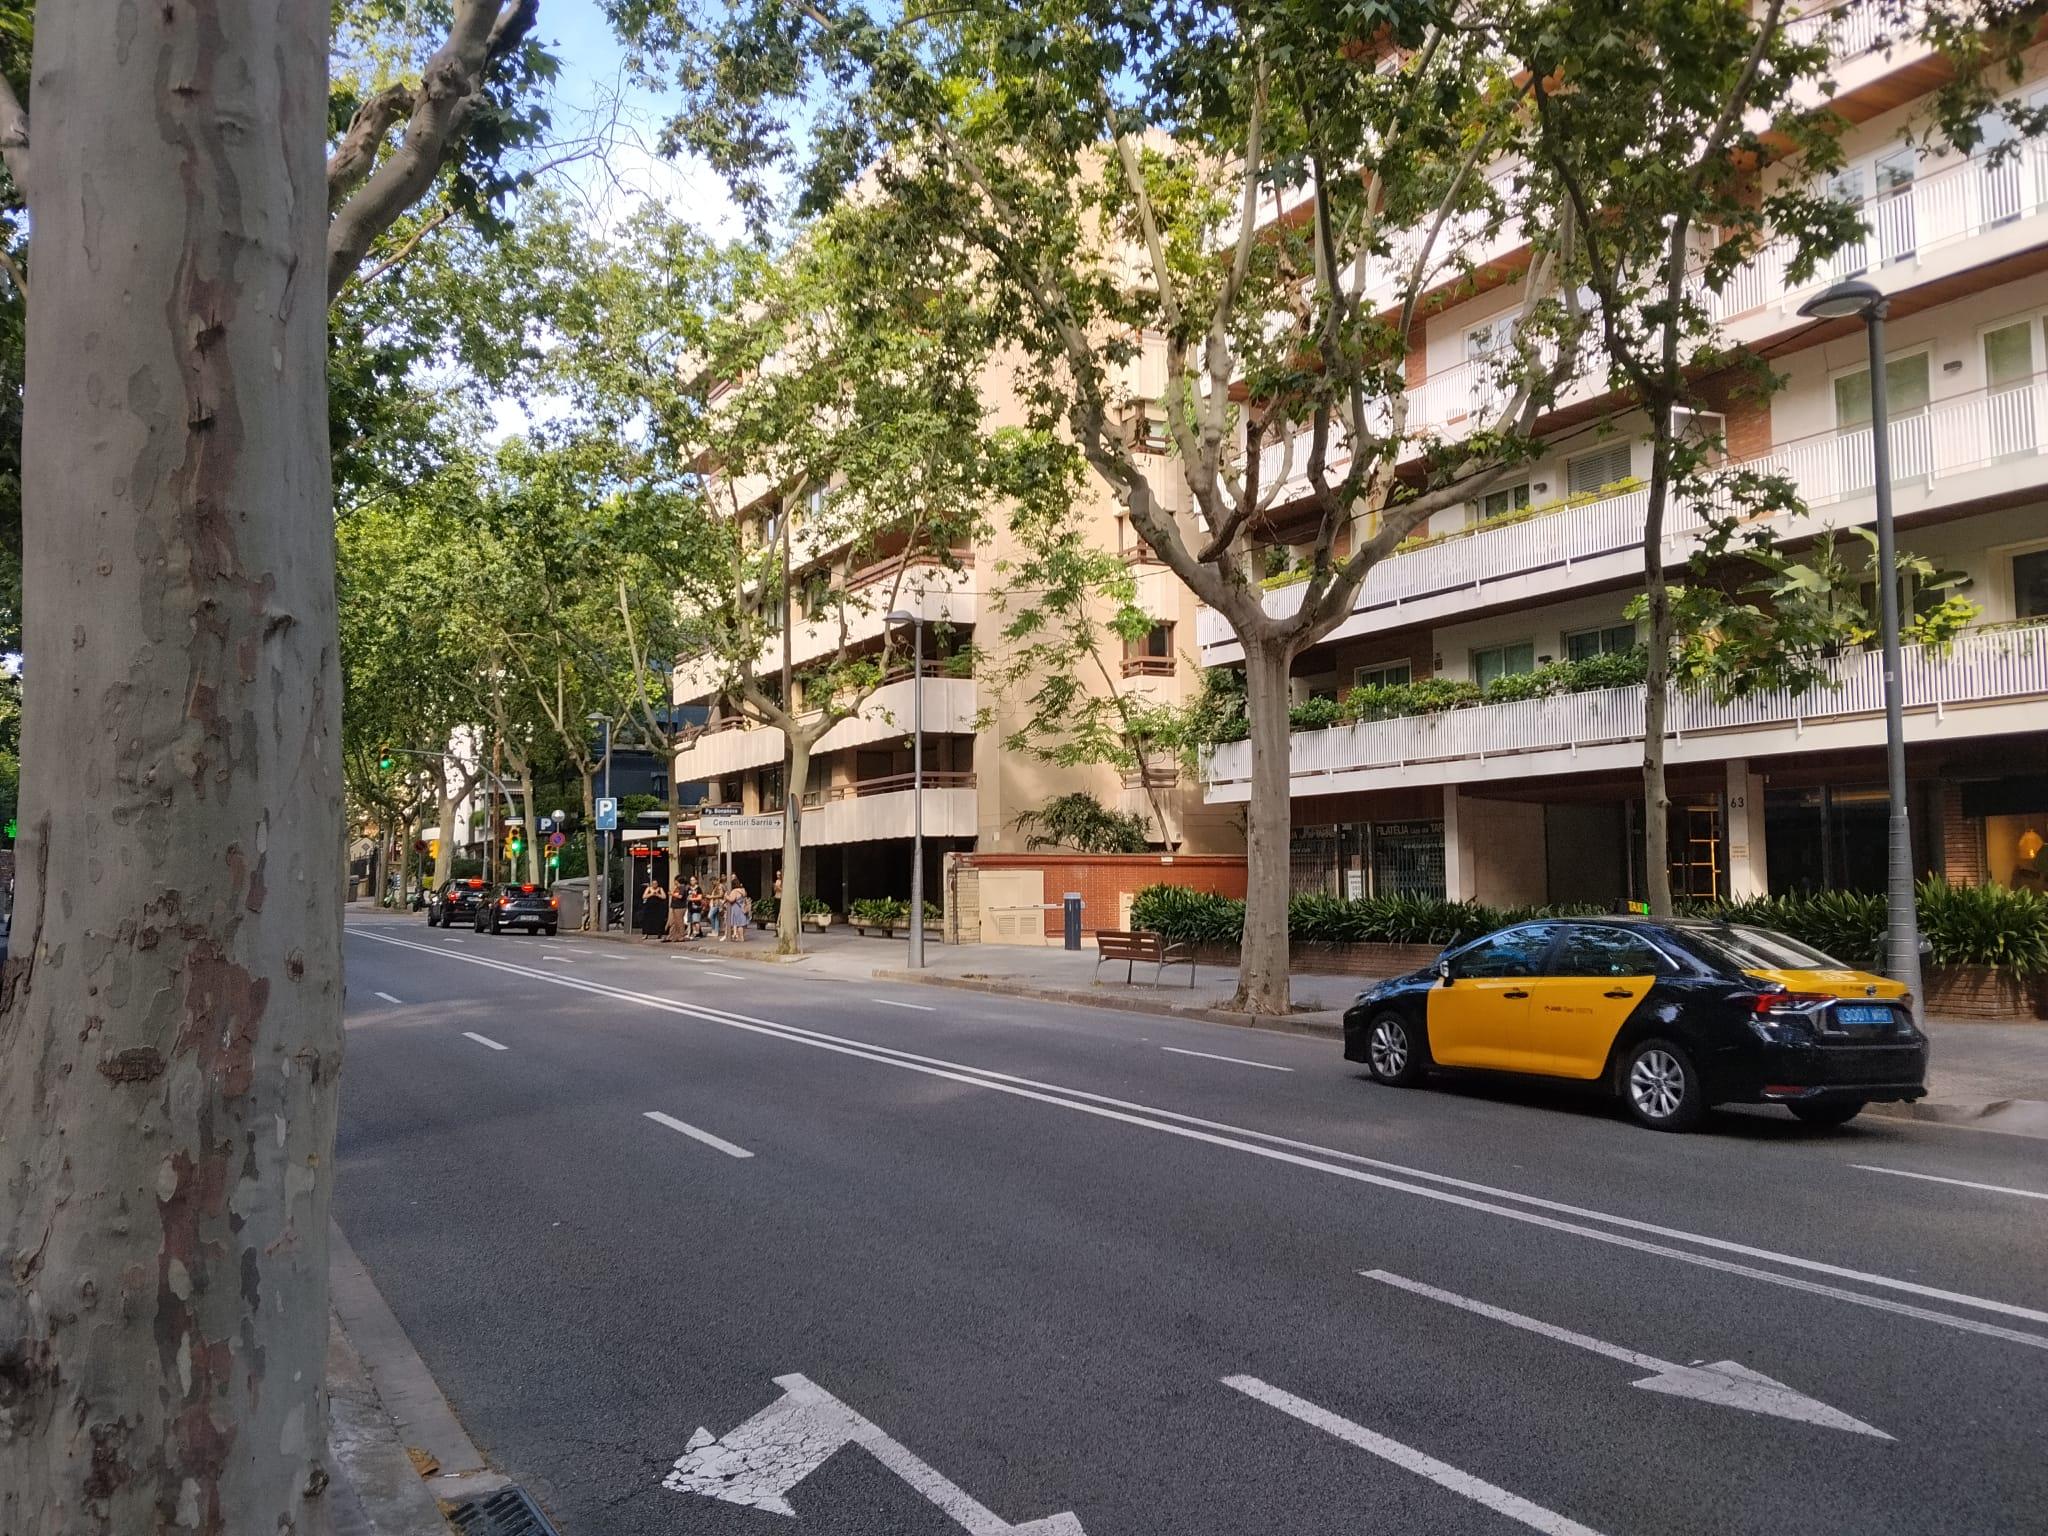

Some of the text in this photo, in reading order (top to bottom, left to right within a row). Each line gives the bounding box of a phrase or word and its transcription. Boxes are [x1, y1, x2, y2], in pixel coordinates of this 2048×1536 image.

[1730, 796, 1745, 808] 63
[599, 800, 613, 817] P
[540, 818, 552, 830] P
